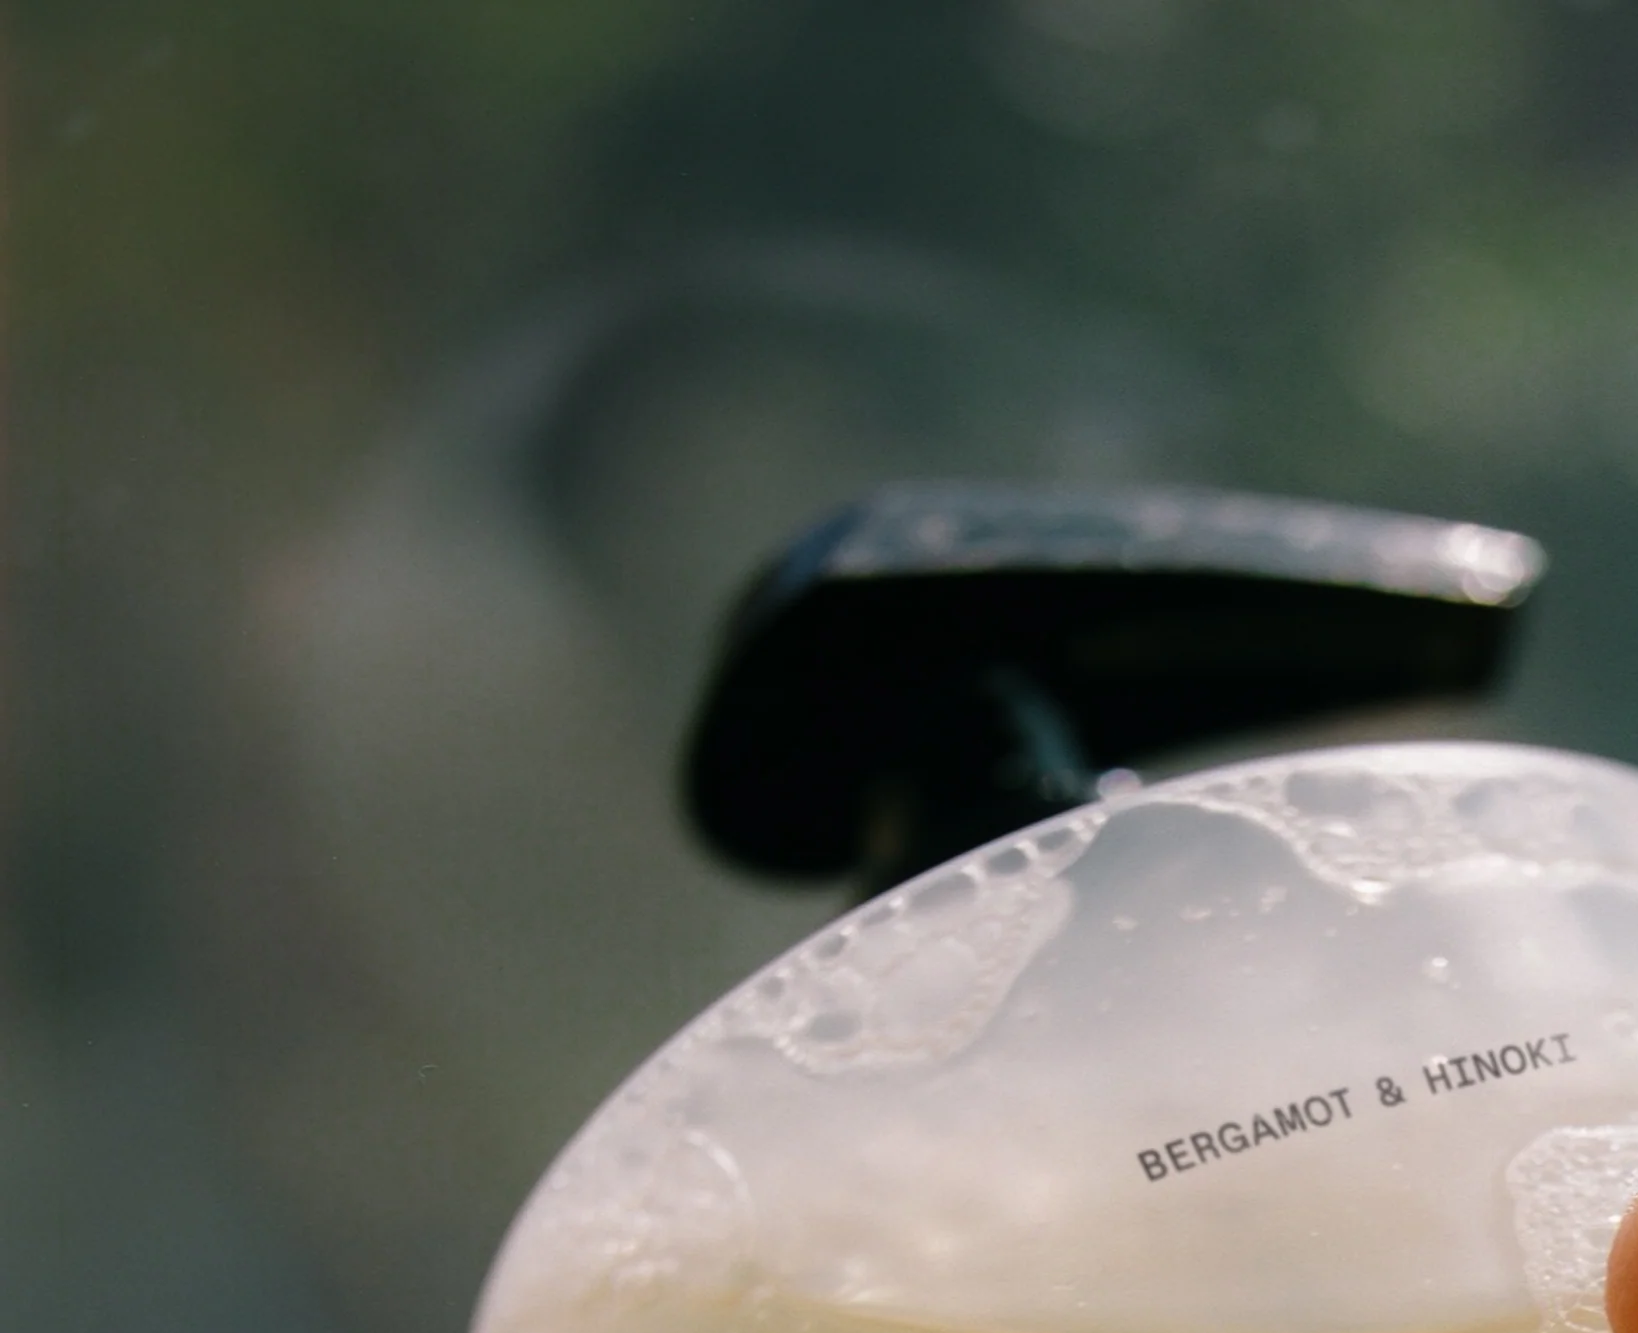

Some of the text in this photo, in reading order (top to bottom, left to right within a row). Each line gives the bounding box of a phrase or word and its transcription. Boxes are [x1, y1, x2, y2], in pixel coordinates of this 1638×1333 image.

[1137, 1032, 1577, 1182] BERGAMOT & HINOKI
